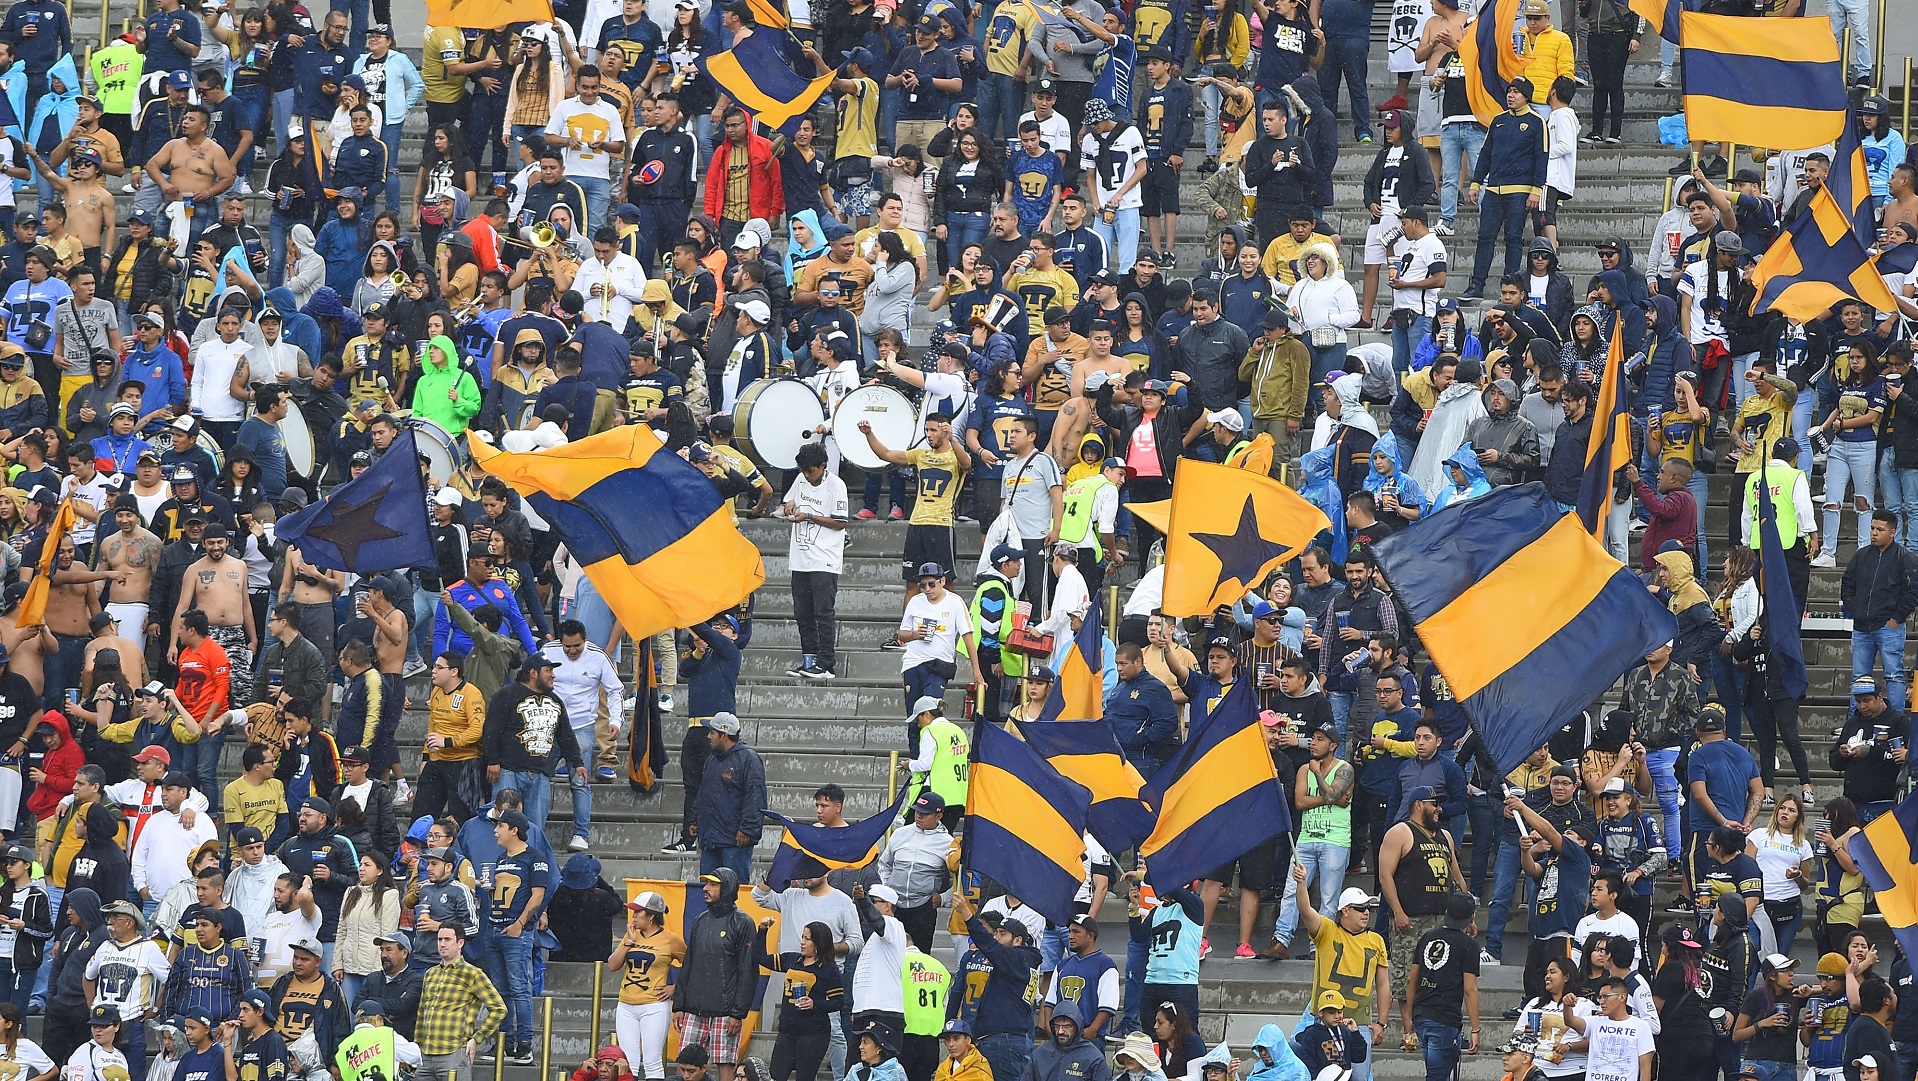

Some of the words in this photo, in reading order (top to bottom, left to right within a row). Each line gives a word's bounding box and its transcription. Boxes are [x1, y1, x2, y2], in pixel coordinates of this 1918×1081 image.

[994, 406, 1025, 415] DHL
[244, 800, 277, 809] Banamex
[103, 955, 136, 964] Banamex
[912, 972, 943, 984] TECATE
[289, 991, 317, 999] DHL
[919, 988, 937, 1008] 81
[1599, 1025, 1636, 1037] NORTE
[348, 1043, 382, 1071] TECATE
[1065, 1069, 1083, 1077] PUMAS
